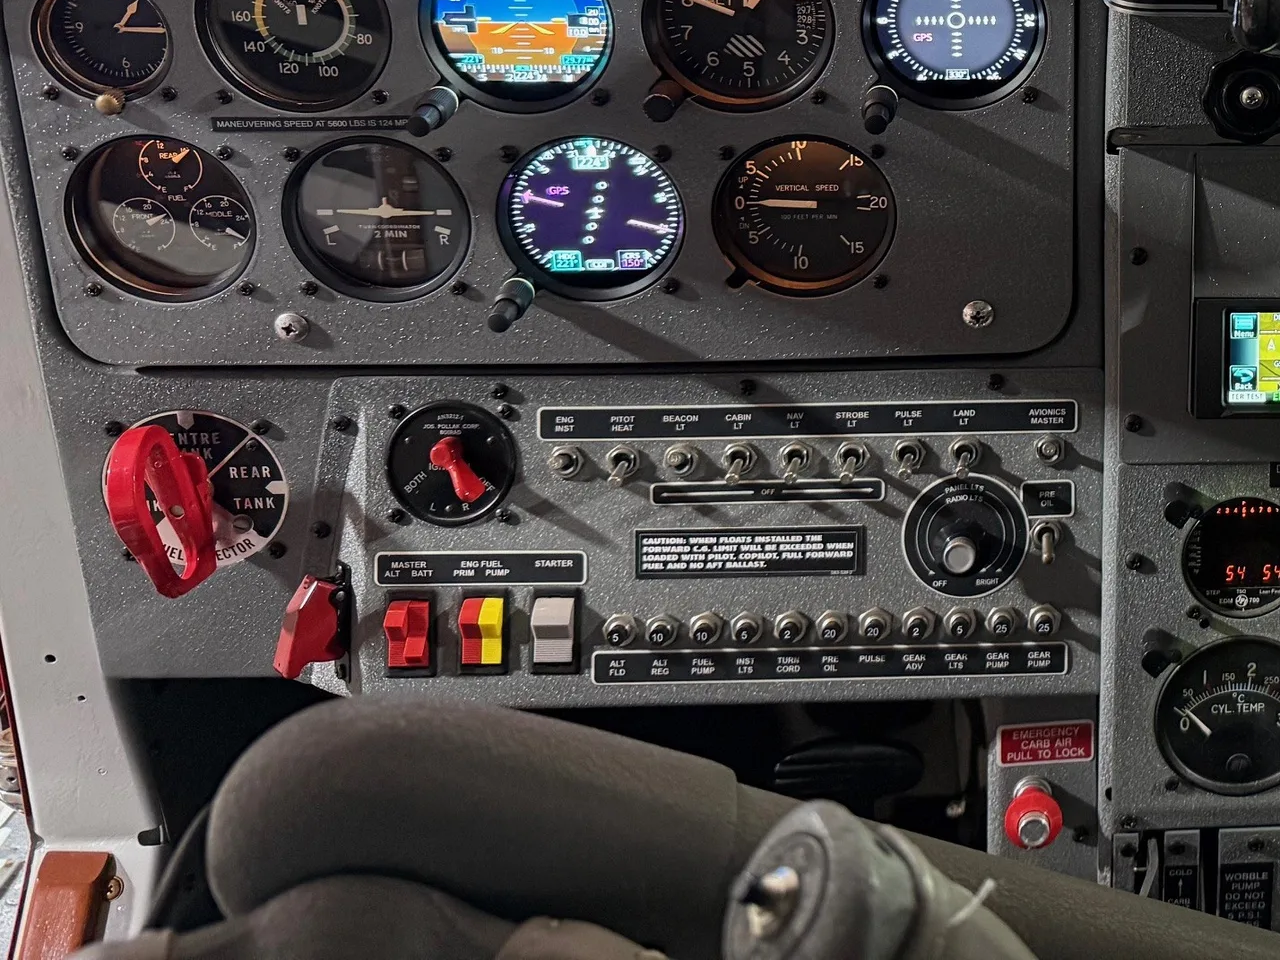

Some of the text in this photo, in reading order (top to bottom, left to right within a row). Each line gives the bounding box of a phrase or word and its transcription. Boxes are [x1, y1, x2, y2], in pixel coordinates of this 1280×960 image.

[232, 11, 250, 22] 160
[357, 34, 372, 44] 80
[913, 34, 933, 42] GPS
[244, 41, 265, 52] 140
[279, 62, 299, 73] 120
[319, 66, 339, 76] 100
[548, 187, 569, 195] GPS
[870, 196, 887, 209] 20
[375, 229, 407, 239] 2 MIN
[611, 415, 635, 423] PITOT
[836, 411, 869, 419] STROBE
[895, 410, 922, 418] PULSE
[675, 423, 685, 431] LT
[903, 418, 913, 426] LT
[229, 466, 271, 479] REAR
[234, 497, 276, 509] TANK
[643, 537, 687, 545] CAUTION:
[754, 535, 802, 543] INSTALLED
[391, 561, 427, 569] MASTER
[461, 560, 503, 568] ENG FUEL
[412, 569, 433, 577] BATT
[454, 569, 475, 577] PRIM
[1226, 565, 1246, 581] 54
[609, 668, 625, 676] FLD
[1012, 727, 1079, 740] EMERGENCY
[1021, 738, 1072, 750] CARB AIR
[1007, 747, 1085, 761] PULL TO LOCK
